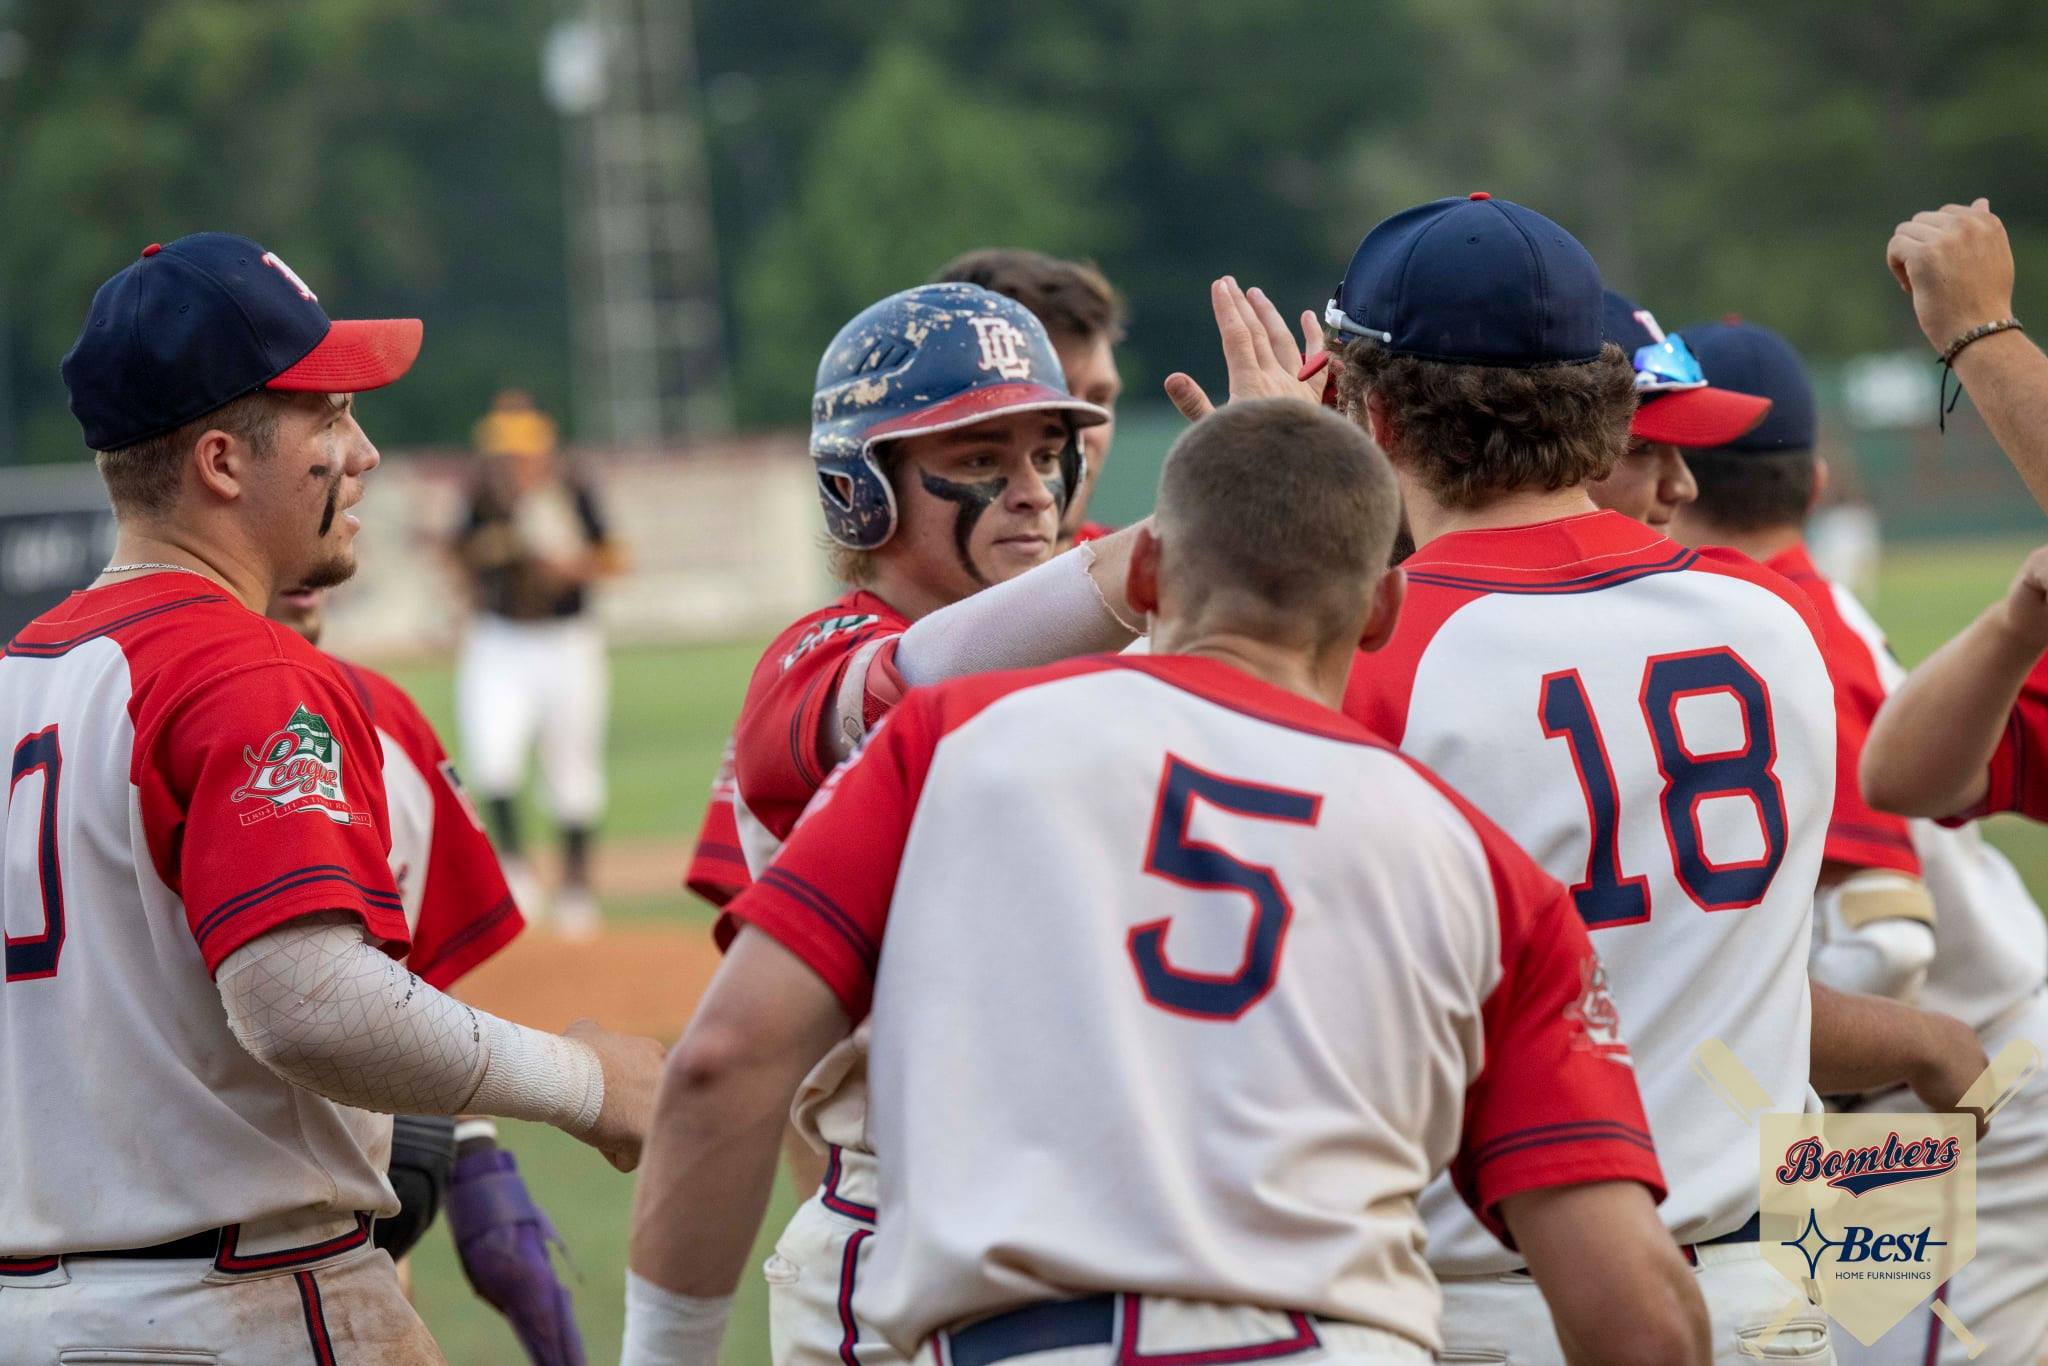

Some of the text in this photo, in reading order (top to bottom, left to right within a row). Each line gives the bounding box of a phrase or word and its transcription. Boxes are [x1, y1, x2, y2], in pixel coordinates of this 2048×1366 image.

[231, 730, 338, 803] League
[1126, 751, 1324, 1024] 5
[1538, 645, 1789, 931] 18
